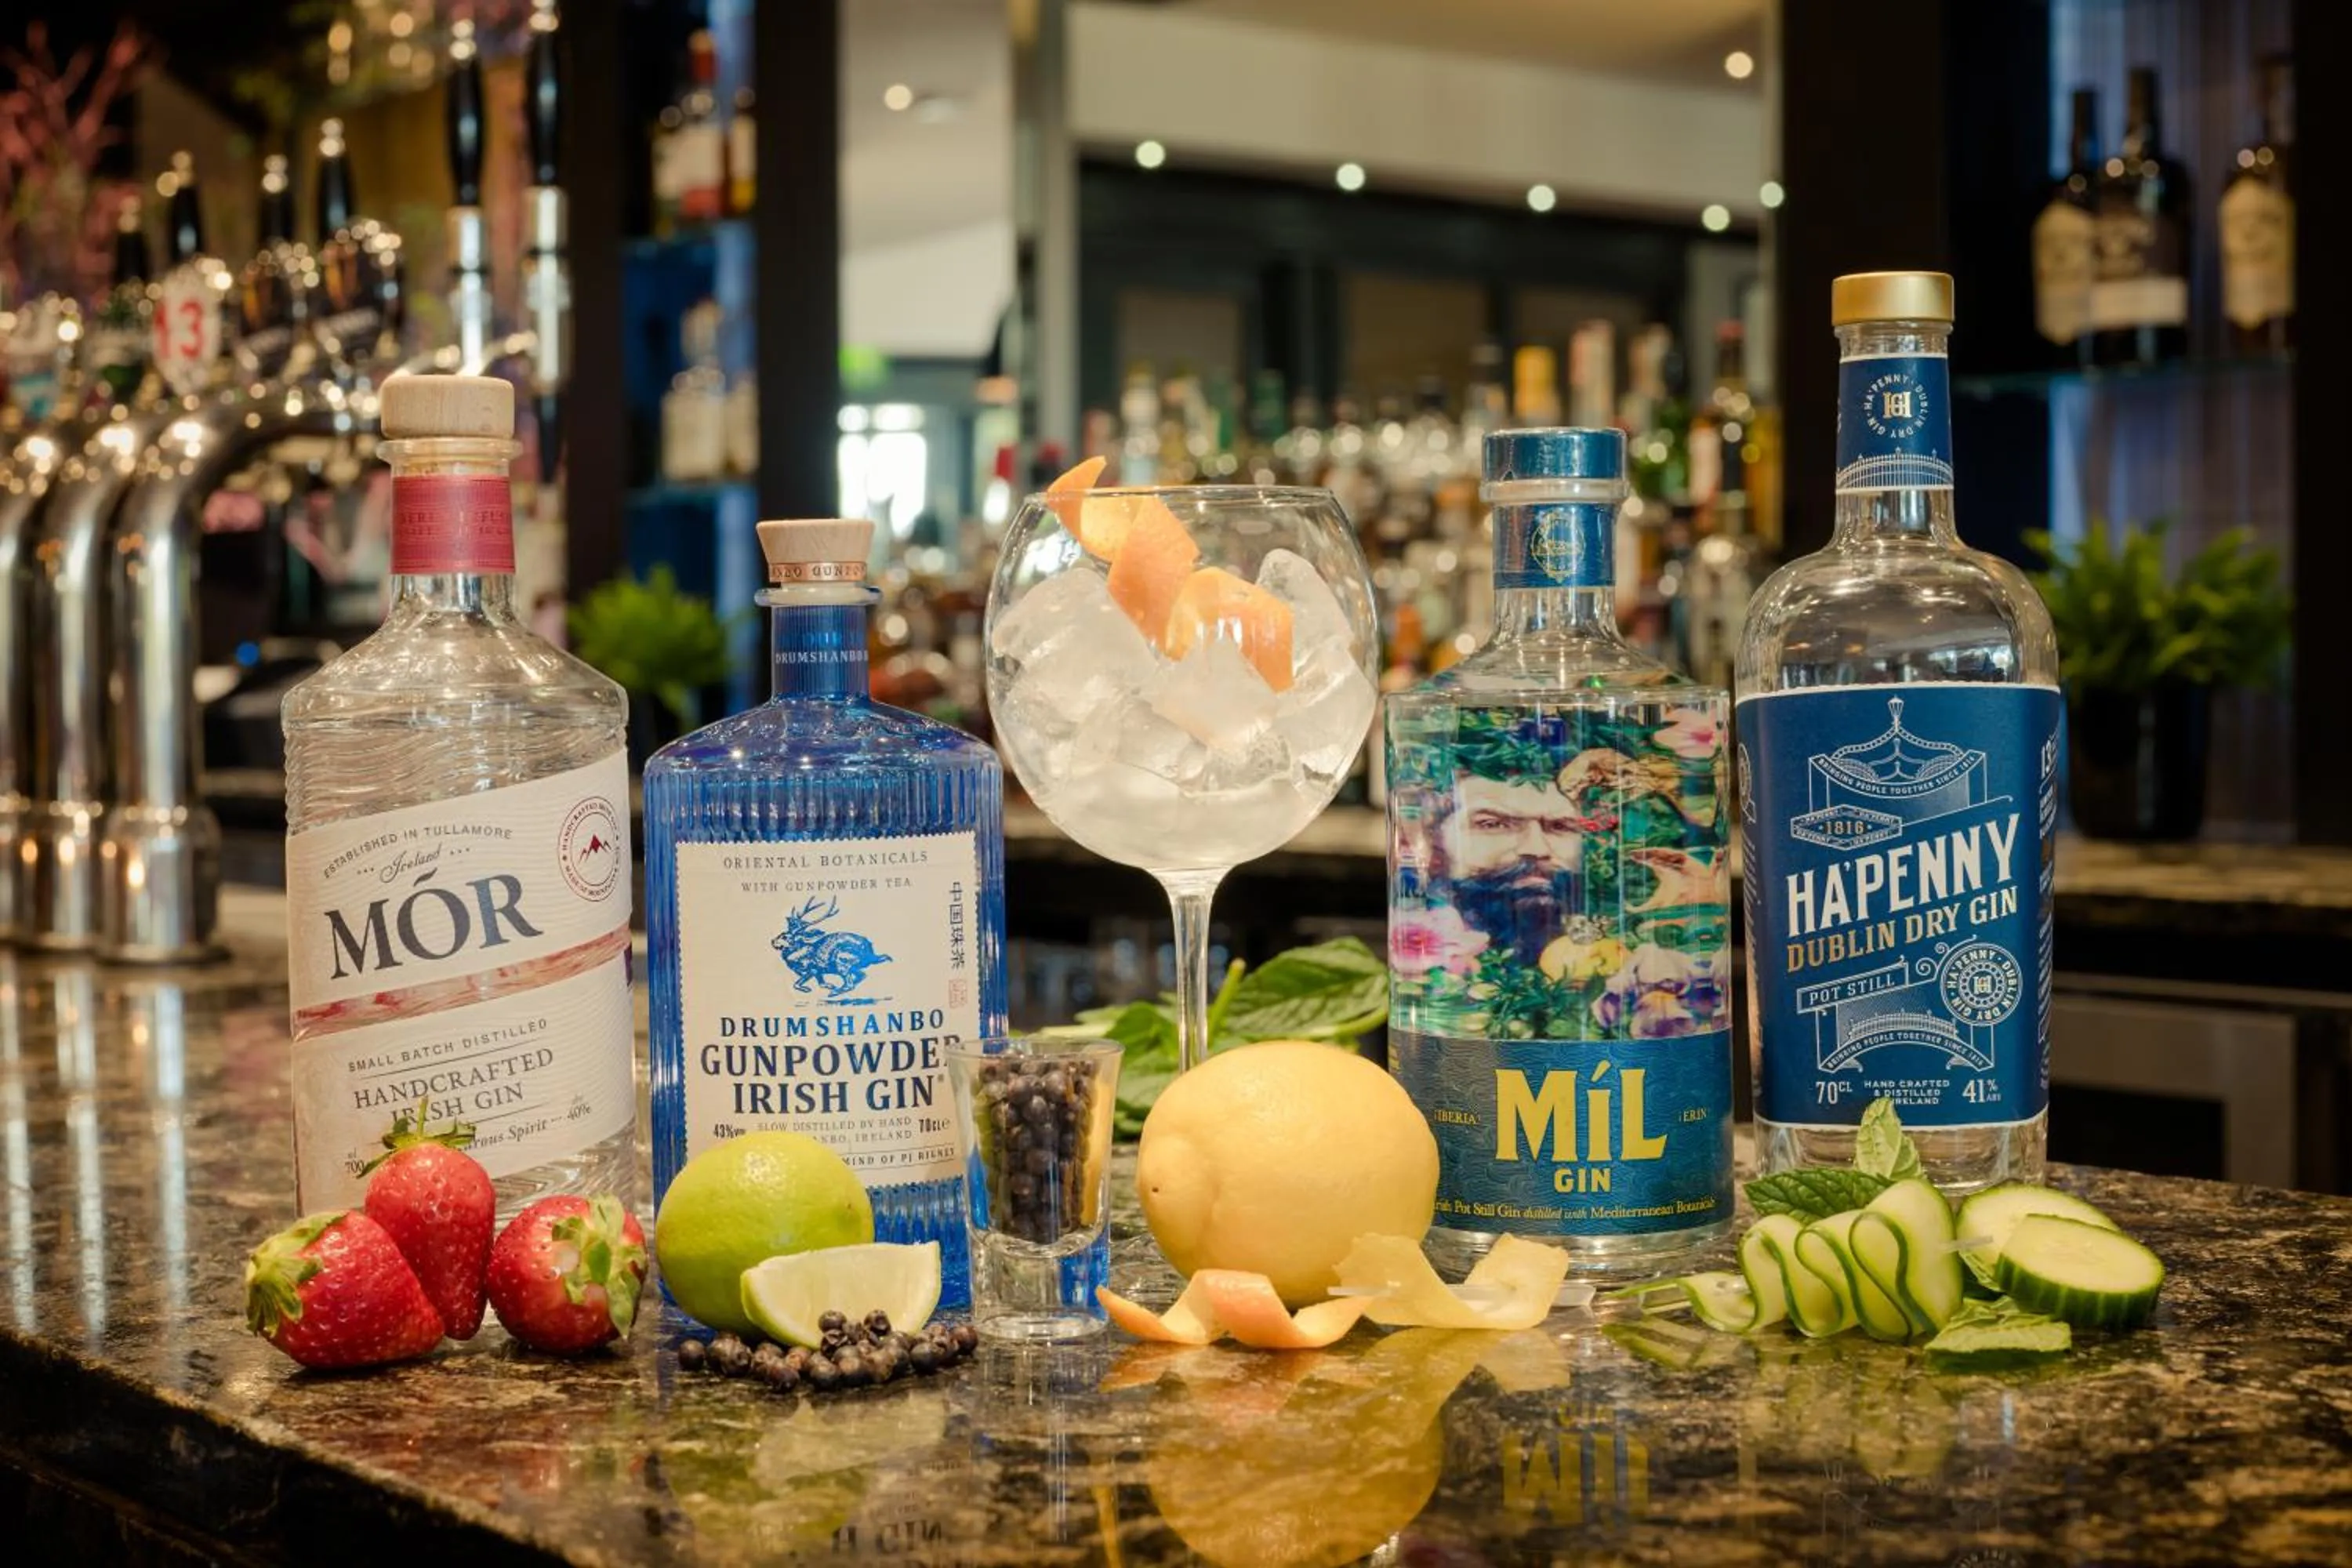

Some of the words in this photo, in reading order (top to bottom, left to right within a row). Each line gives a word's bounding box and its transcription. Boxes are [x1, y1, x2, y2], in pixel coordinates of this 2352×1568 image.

[1867, 417, 1886, 435] GIN
[1890, 426, 1914, 438] DRY
[1856, 782, 1886, 794] PEOPLE
[1890, 782, 1933, 794] TOGETHER
[1936, 768, 1958, 785] SINCE
[1825, 821, 1864, 835] 1816
[324, 833, 398, 879] ESTABLISHED
[404, 829, 419, 840] IN
[424, 825, 514, 840] TULLAMORE
[379, 842, 444, 884] Ireland
[724, 856, 810, 869] ORIENTAL
[820, 851, 928, 867] BOTANICALS
[742, 881, 779, 893] WITH
[786, 878, 878, 892] GUNPOWDER
[885, 877, 913, 889] TEA
[1787, 813, 2020, 938] HA'PENNY
[324, 866, 544, 980] MÓR
[1787, 920, 1896, 973] DUBLIN
[1904, 903, 1960, 943] DRY
[1969, 886, 2018, 924] GIN
[1809, 987, 1840, 1007] POT
[1847, 975, 1895, 996] STILL
[2002, 960, 2017, 1007] DUBLIN
[1951, 997, 1972, 1017] GIN
[1976, 1007, 2001, 1020] DRY
[720, 1009, 944, 1037] DRUMSHANBO
[348, 1054, 394, 1073] SMALL
[402, 1041, 455, 1062] BATCH
[462, 1018, 547, 1049] DISTILLED
[1864, 1031, 1894, 1047] PEOPLE
[1897, 1032, 1942, 1044] TOGETHER
[1944, 1039, 1965, 1054] SINCE
[354, 1047, 554, 1109] HANDCRAFTED
[1864, 1080, 1895, 1088] HAND
[1899, 1079, 1950, 1087] CRAFTED
[392, 1097, 465, 1126] IRSH
[474, 1082, 524, 1110] GIN
[732, 1080, 850, 1115] IRISH
[865, 1074, 934, 1112] GIN
[1884, 1088, 1940, 1097] DISTILLED
[508, 1118, 546, 1142] Spirit
[757, 1123, 787, 1132] SLOW
[793, 1120, 855, 1131] DISTILLED
[860, 1119, 874, 1129] BY
[880, 1116, 912, 1128] HAND
[855, 1130, 912, 1142] IRELAND
[880, 1155, 895, 1164] OF
[901, 1153, 912, 1163] PJ
[1554, 1167, 1612, 1193] GIN
[1454, 1200, 1471, 1214] Pot
[1473, 1201, 1494, 1216] Still
[1497, 1203, 1520, 1218] Gin
[1522, 1206, 1563, 1219] distilled
[1564, 1207, 1588, 1219] with
[1591, 1204, 1675, 1219] Mediterranean
